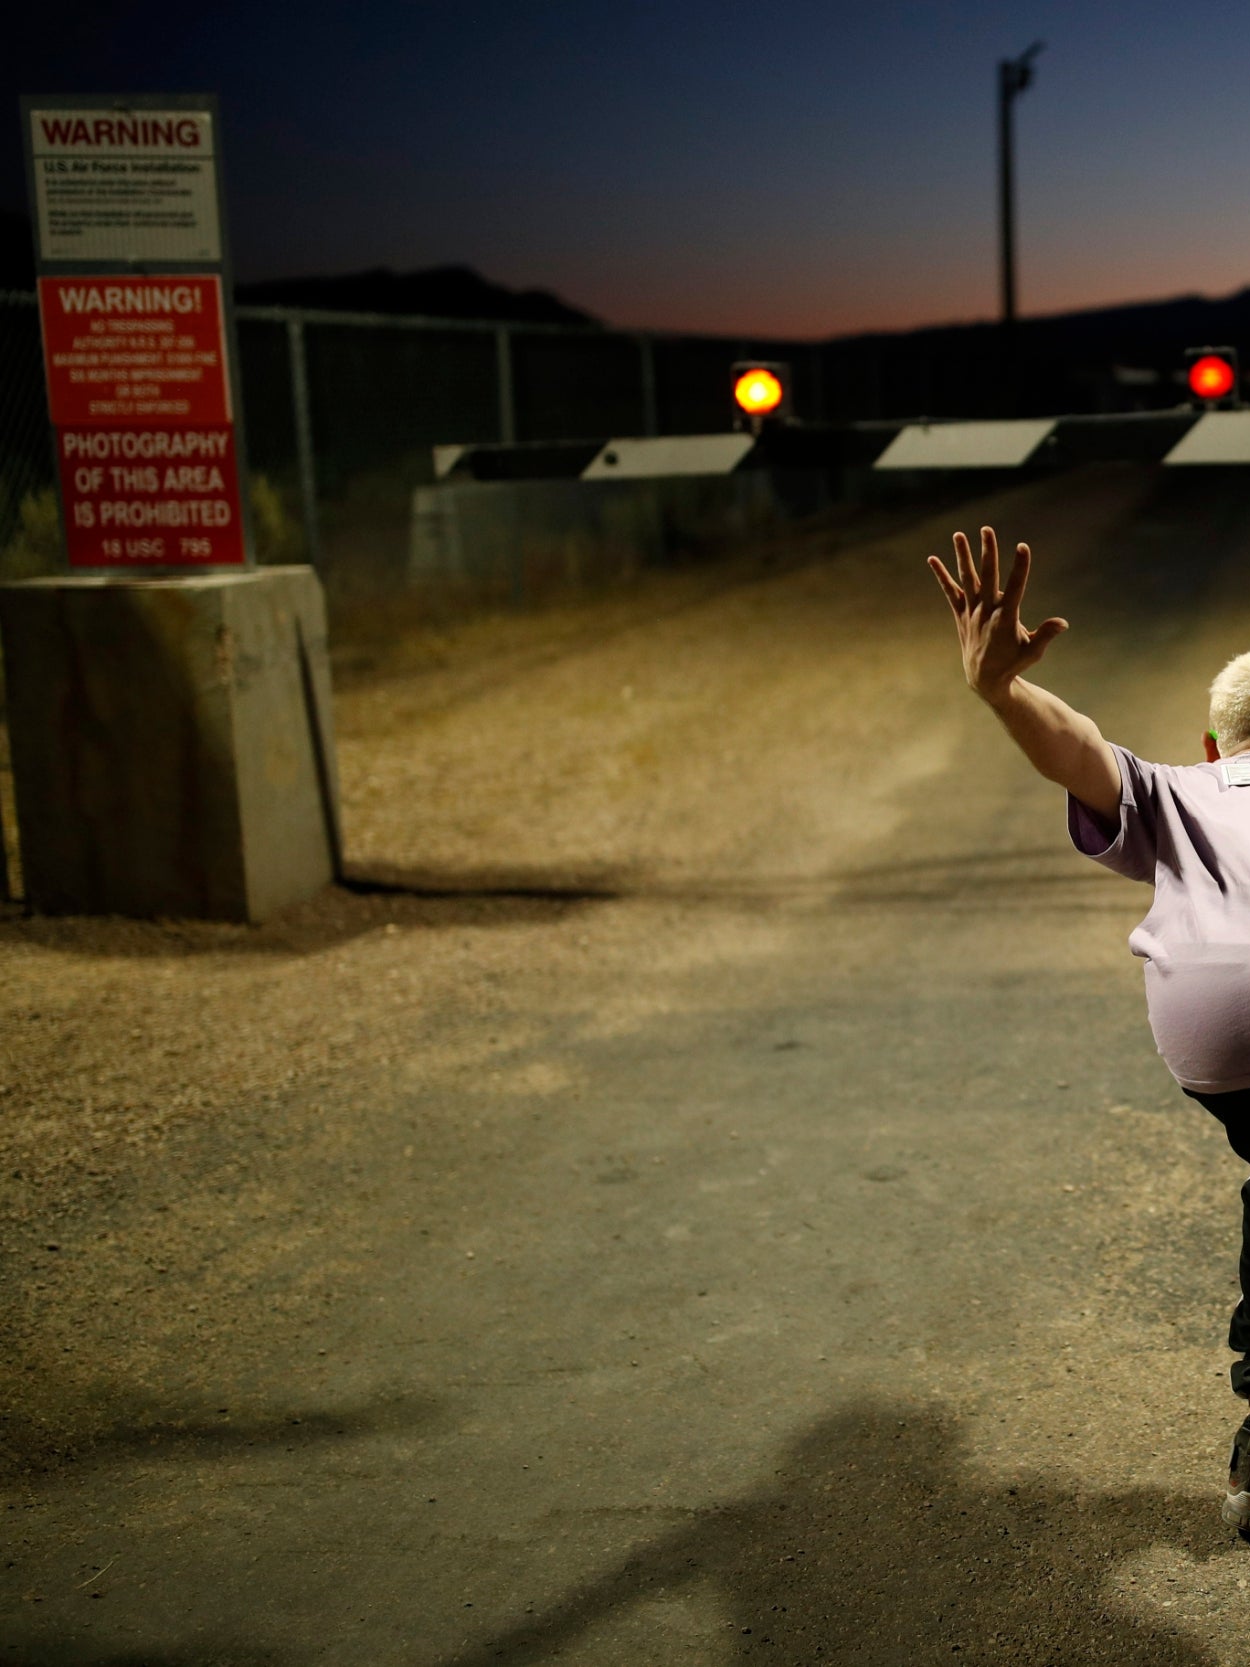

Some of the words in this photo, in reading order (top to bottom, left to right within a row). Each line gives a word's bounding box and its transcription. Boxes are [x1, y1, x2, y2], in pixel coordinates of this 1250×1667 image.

[41, 119, 199, 147] WARNING
[92, 160, 127, 173] Force
[59, 286, 202, 314] WARNING!
[63, 431, 229, 459] PHOTOGRAPHY
[74, 466, 104, 494] OF
[108, 466, 160, 493] THIS
[163, 465, 225, 493] AREA
[73, 500, 96, 528] IS
[99, 499, 232, 528] PROHIBITED
[125, 537, 166, 557] USC
